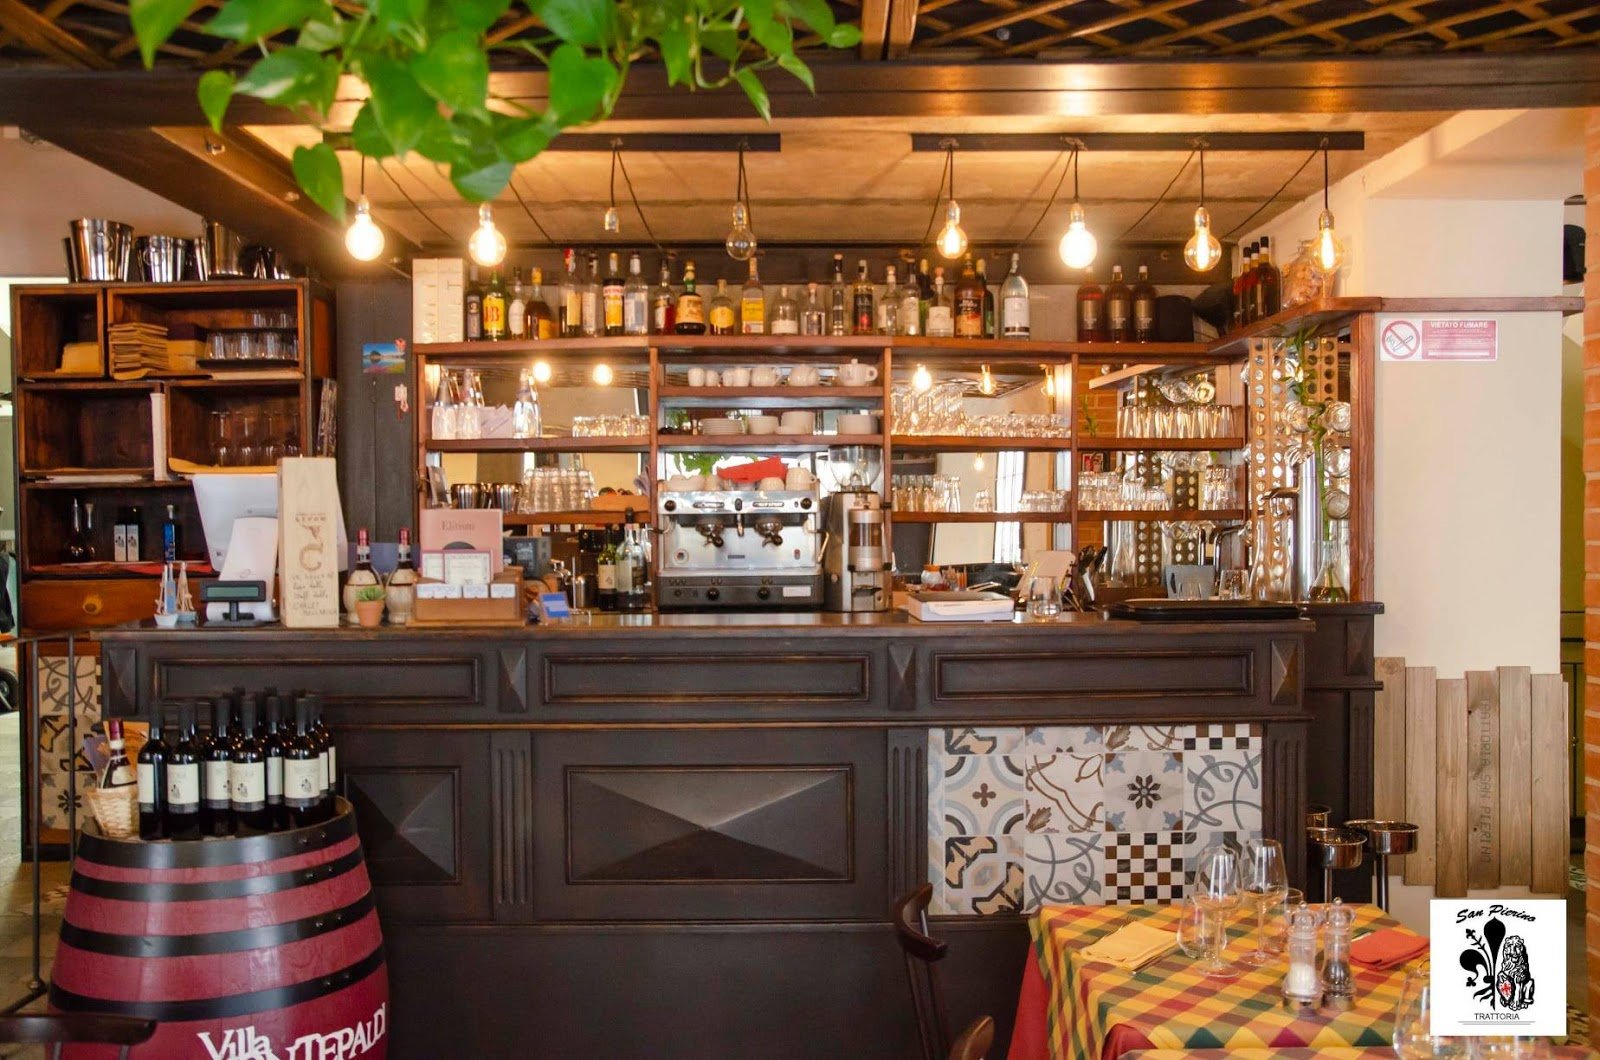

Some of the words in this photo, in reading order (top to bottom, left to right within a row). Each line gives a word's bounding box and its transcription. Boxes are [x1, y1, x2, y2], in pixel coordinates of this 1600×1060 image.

[1480, 774, 1492, 799] SAN
[1480, 806, 1492, 863] PIERINO
[196, 1025, 270, 1060] Villa
